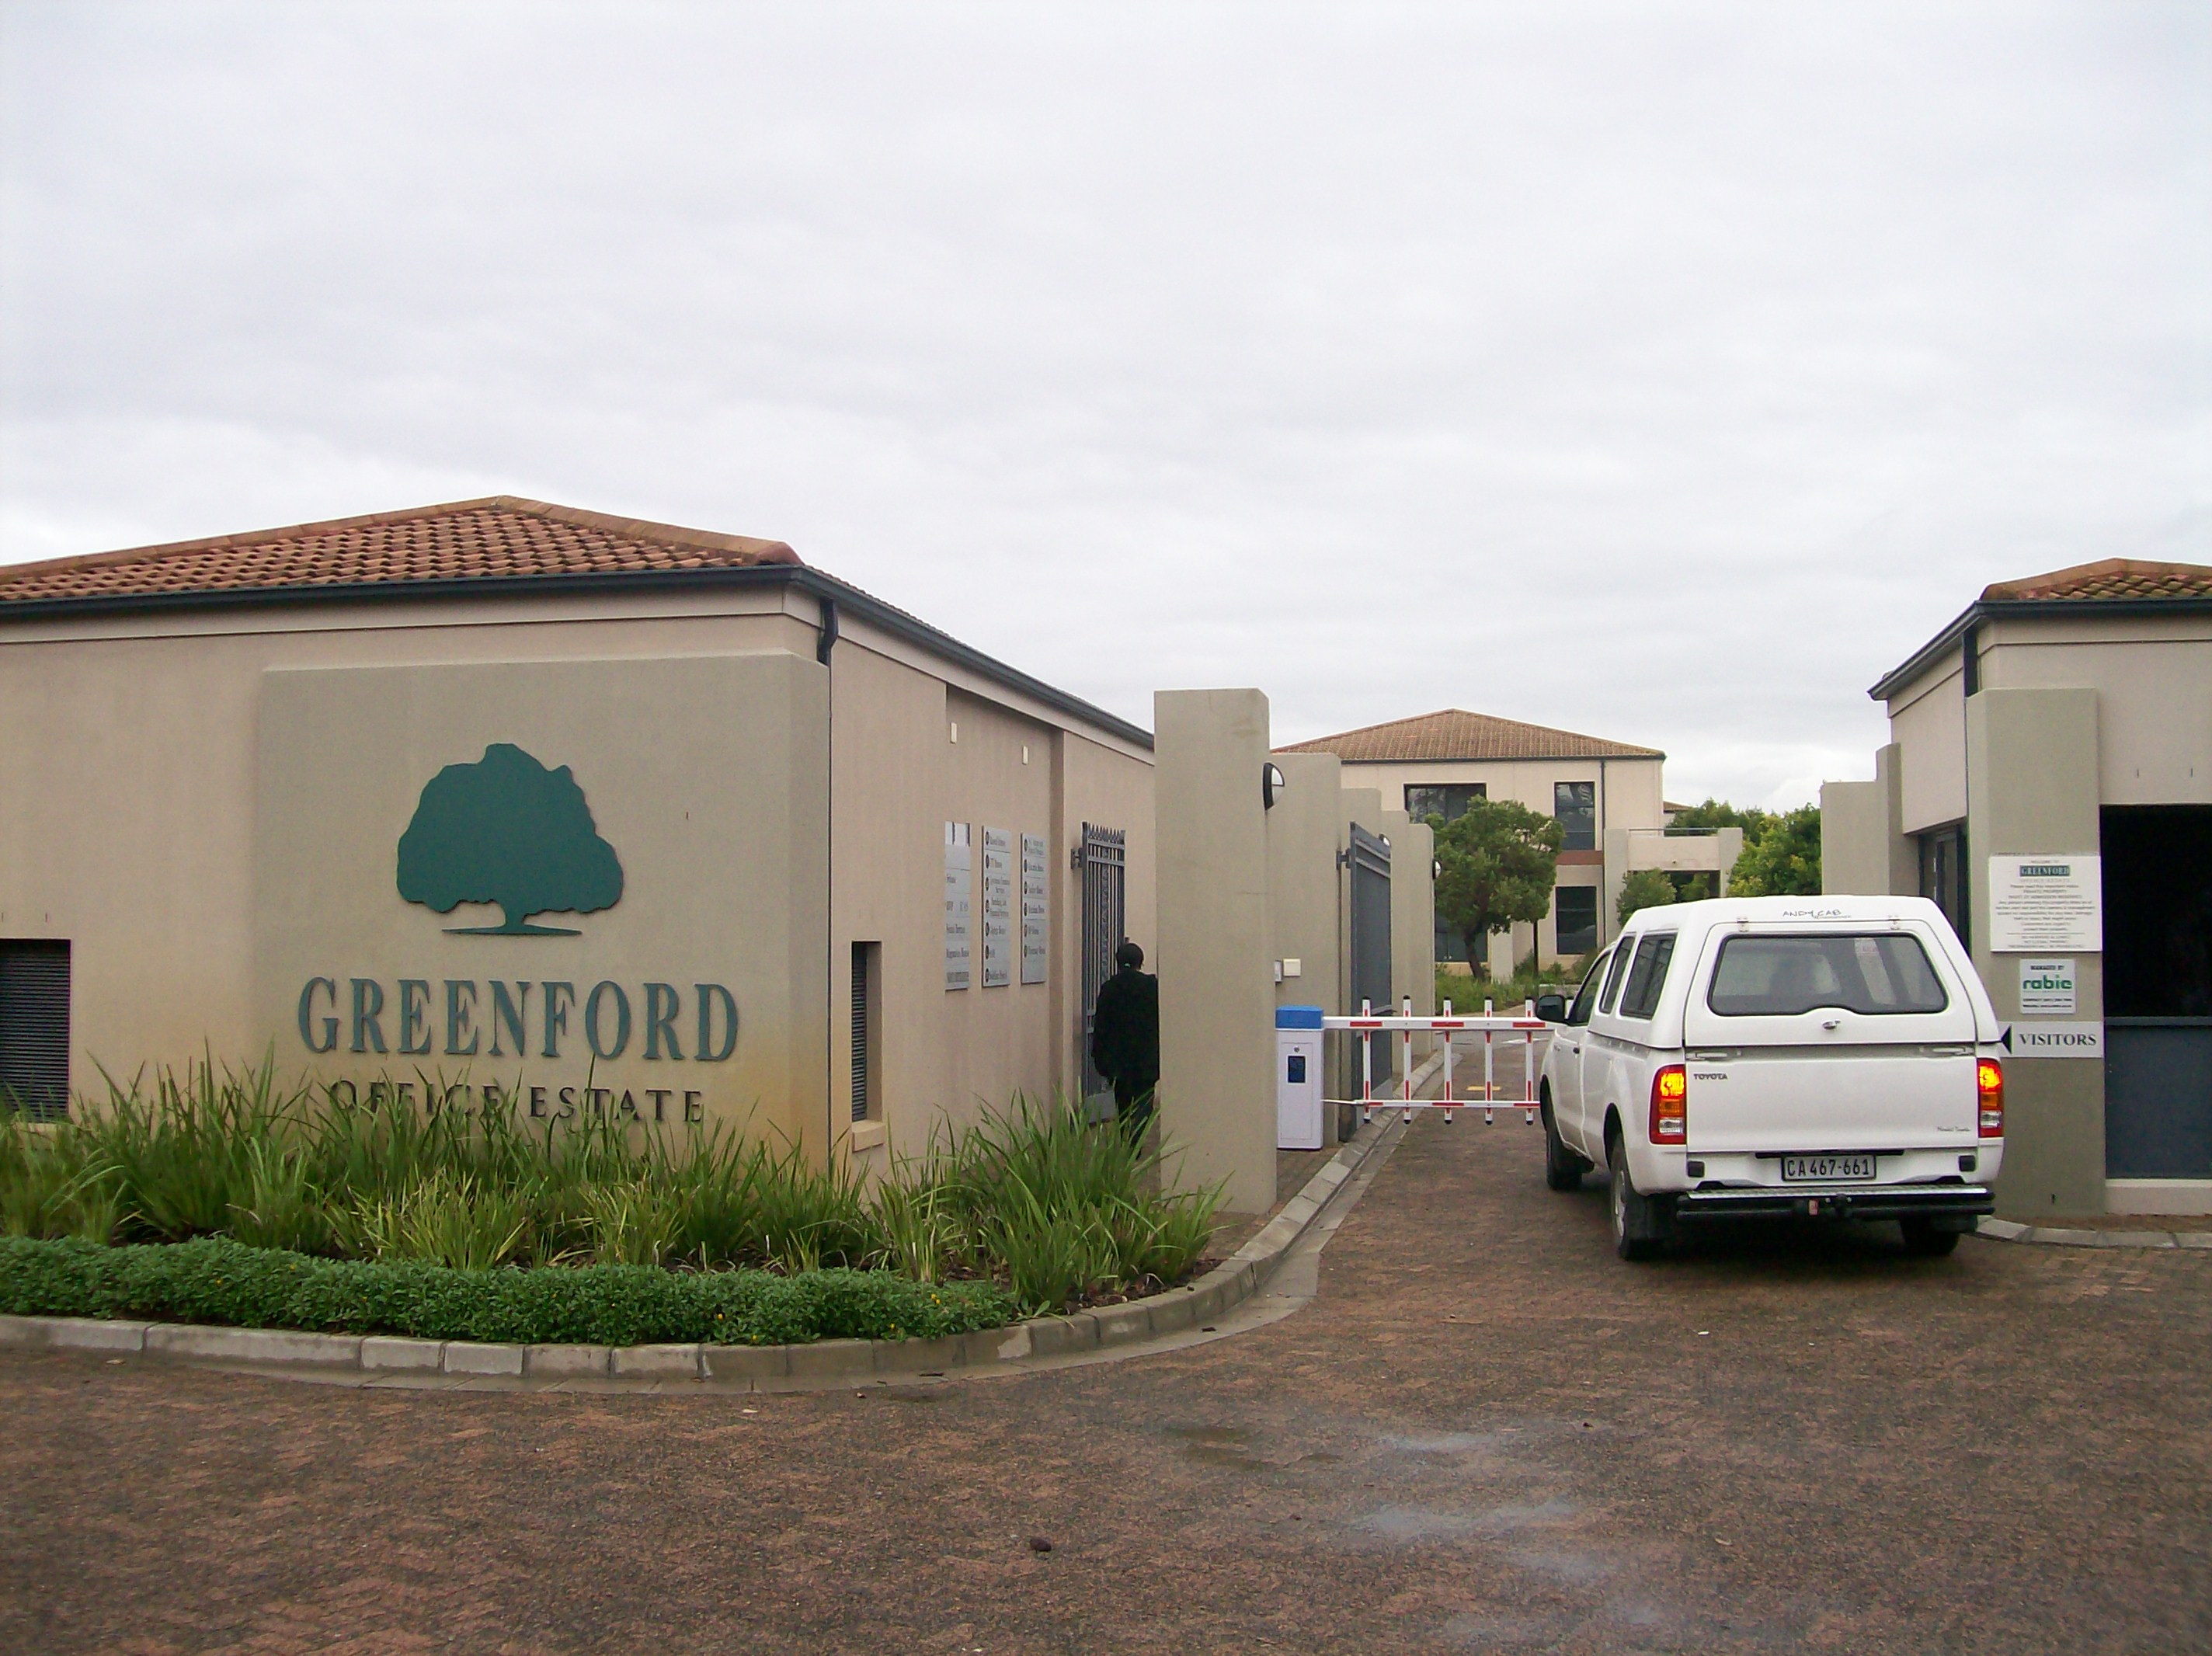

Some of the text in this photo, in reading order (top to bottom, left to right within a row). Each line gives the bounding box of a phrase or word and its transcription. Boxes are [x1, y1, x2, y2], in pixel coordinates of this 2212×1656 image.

[2022, 974, 2073, 990] rabie
[298, 976, 739, 1060] GREENFORD
[2019, 1034, 2097, 1045] VISITORS
[528, 1086, 702, 1122] ESTATE
